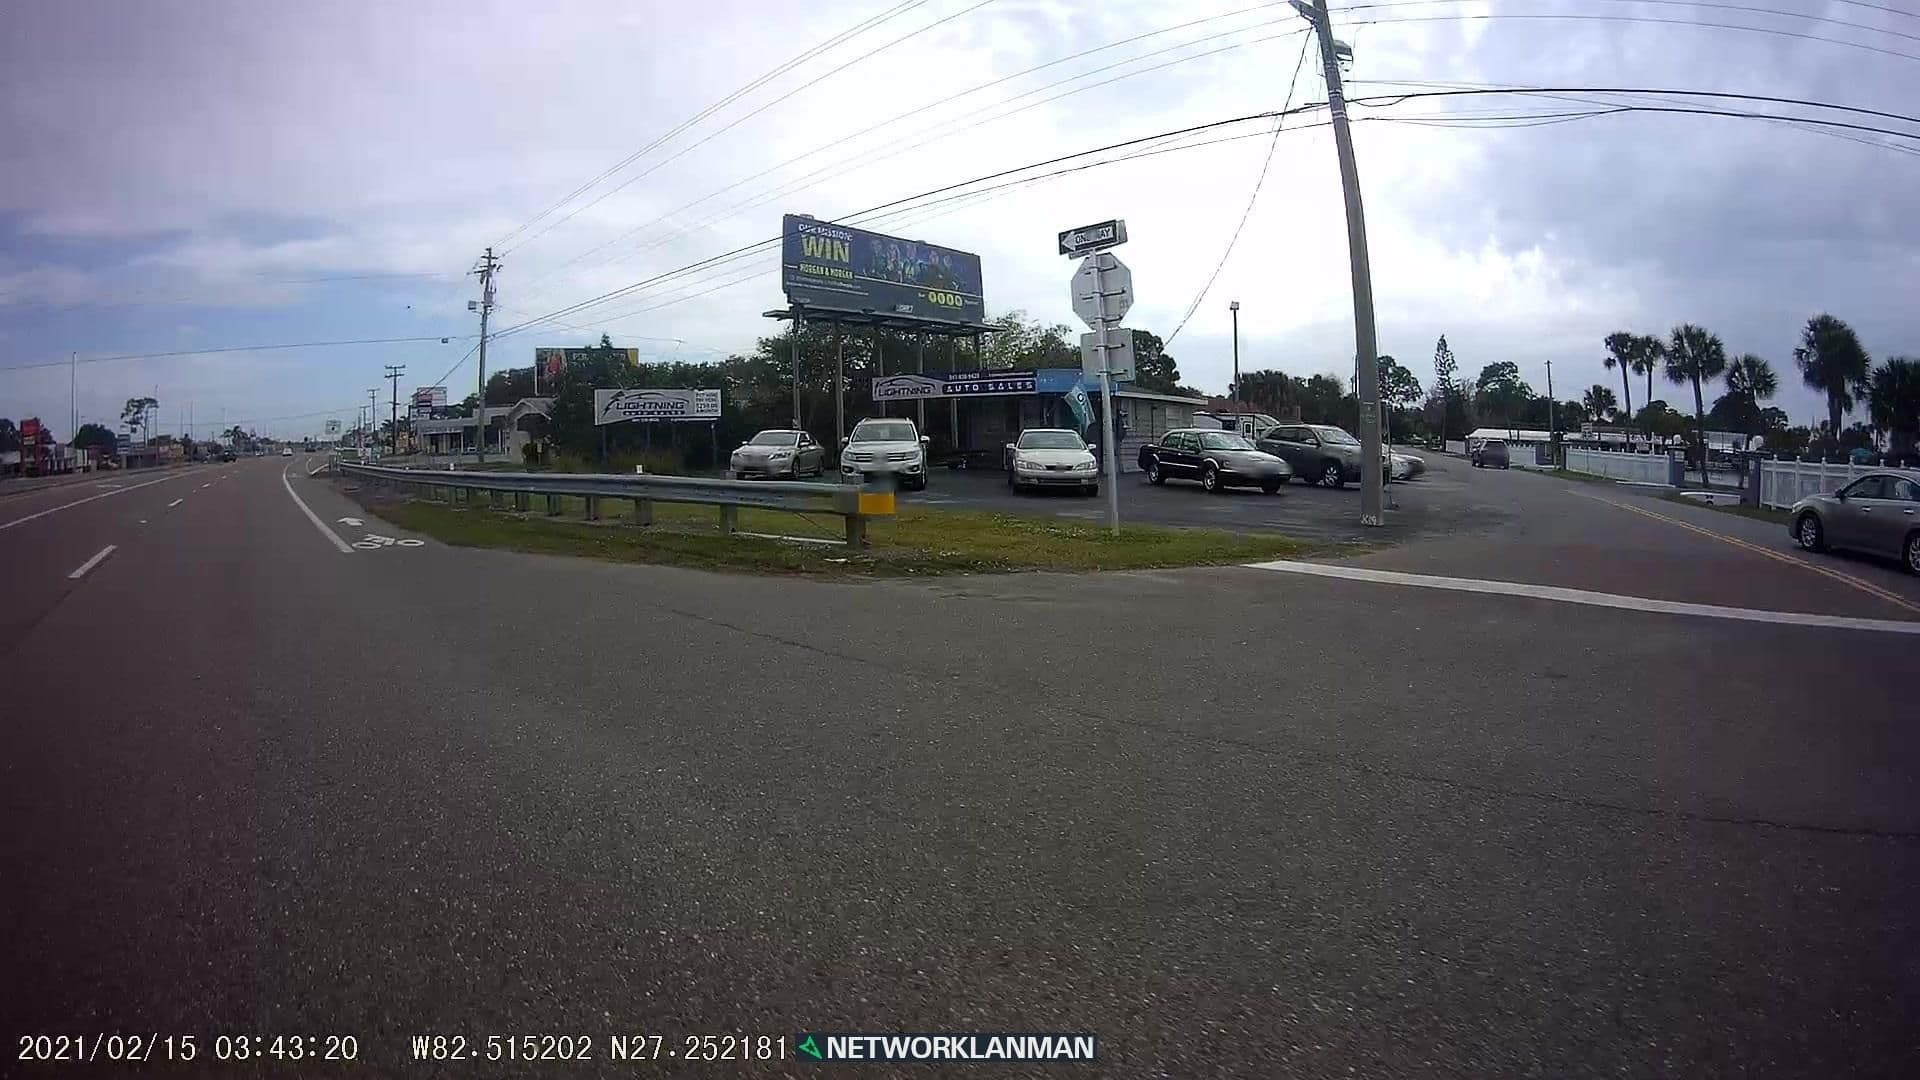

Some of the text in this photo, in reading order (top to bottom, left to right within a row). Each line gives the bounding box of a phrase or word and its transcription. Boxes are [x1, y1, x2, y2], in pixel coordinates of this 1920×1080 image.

[801, 233, 850, 263] WIN
[946, 381, 1033, 393] AUTO SALES
[616, 401, 685, 410] LIGHTNING
